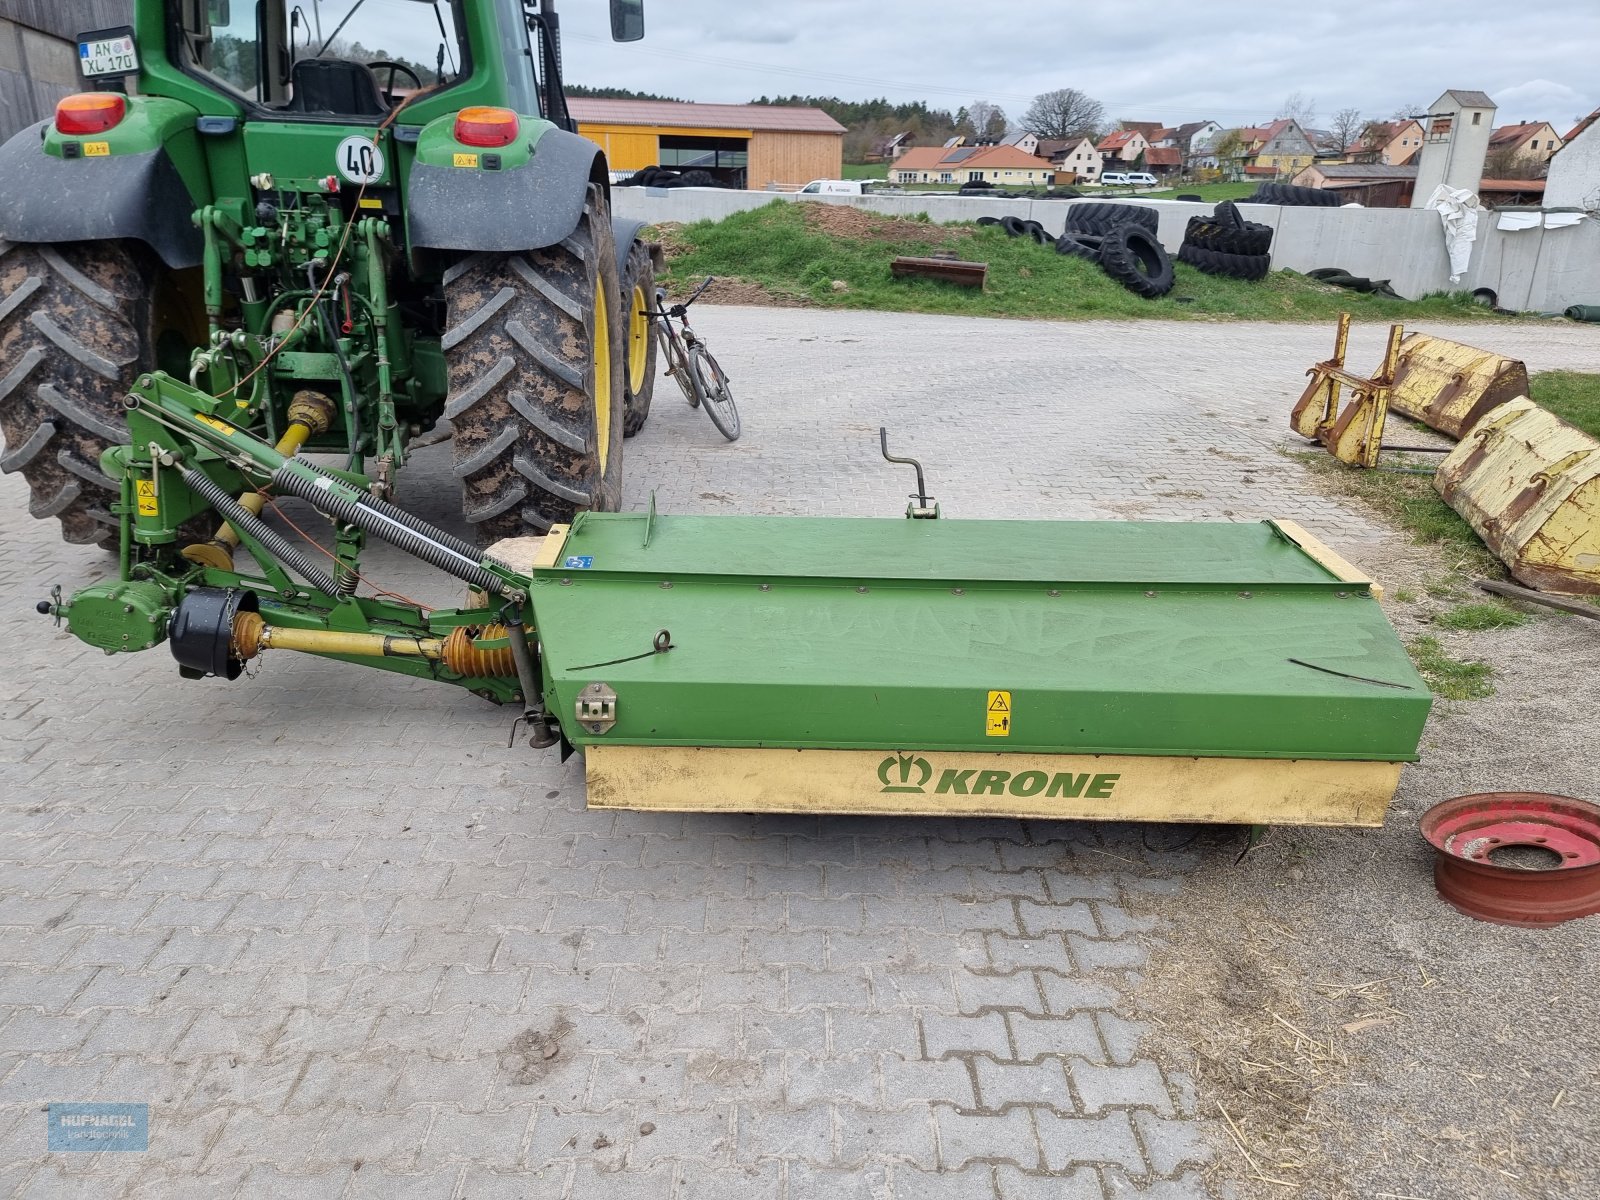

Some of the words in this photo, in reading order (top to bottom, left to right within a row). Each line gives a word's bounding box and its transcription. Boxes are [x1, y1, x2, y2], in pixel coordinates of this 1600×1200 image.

[95, 43, 111, 57] AN
[86, 59, 105, 73] XL
[108, 55, 132, 71] 170
[347, 145, 375, 176] 40
[934, 769, 1121, 799] KRONE
